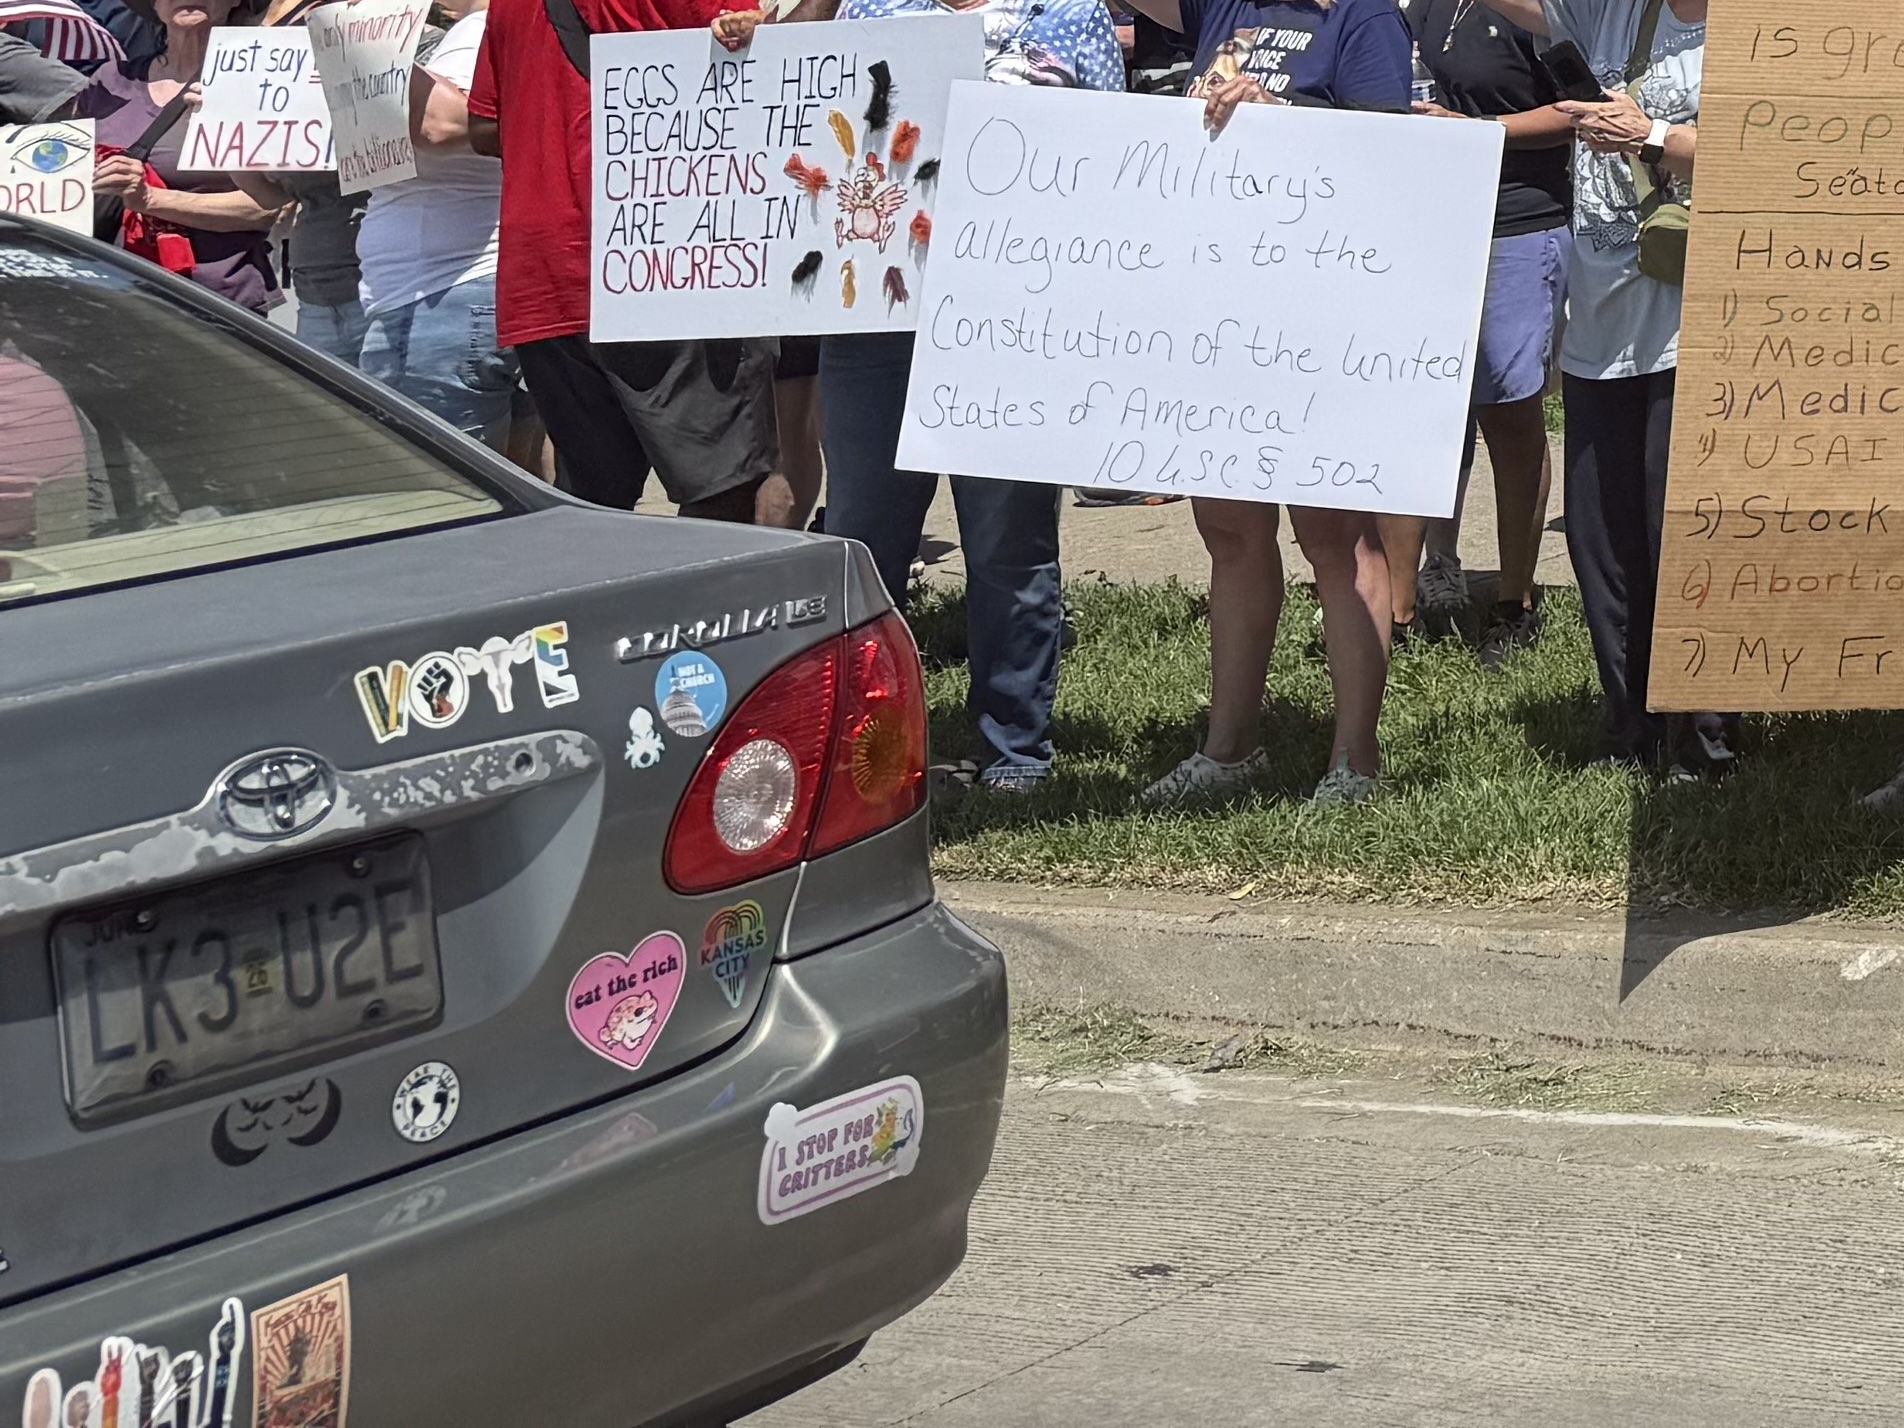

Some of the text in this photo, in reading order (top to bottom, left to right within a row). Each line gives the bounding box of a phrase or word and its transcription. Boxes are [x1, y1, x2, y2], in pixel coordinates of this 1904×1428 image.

[349, 4, 423, 53] minority
[1256, 27, 1313, 51] IF YOUR
[203, 39, 308, 86] just say
[604, 52, 857, 110] EGGS ARE HIGH
[1249, 50, 1286, 70] VOICE
[259, 78, 290, 112] to
[190, 119, 333, 169] NAZIS!
[606, 104, 820, 155] BECAUSE THE
[606, 152, 768, 201] CHICKENS
[967, 117, 1336, 225] Our Military's
[607, 199, 746, 246] ARE ALL
[603, 242, 768, 294] CONGRESS!
[954, 217, 1392, 293] allegiance is to the
[1735, 229, 1891, 271] Hands
[931, 294, 1321, 373] Constitution of the
[918, 381, 1314, 438] States of America!
[786, 597, 828, 625] LE
[354, 621, 580, 744] VOTE
[1733, 636, 1805, 693] My
[701, 930, 764, 966] KANSAS
[715, 952, 750, 979] CITY
[574, 953, 679, 1010] eat the rich
[777, 1113, 875, 1172] I STOP FOR
